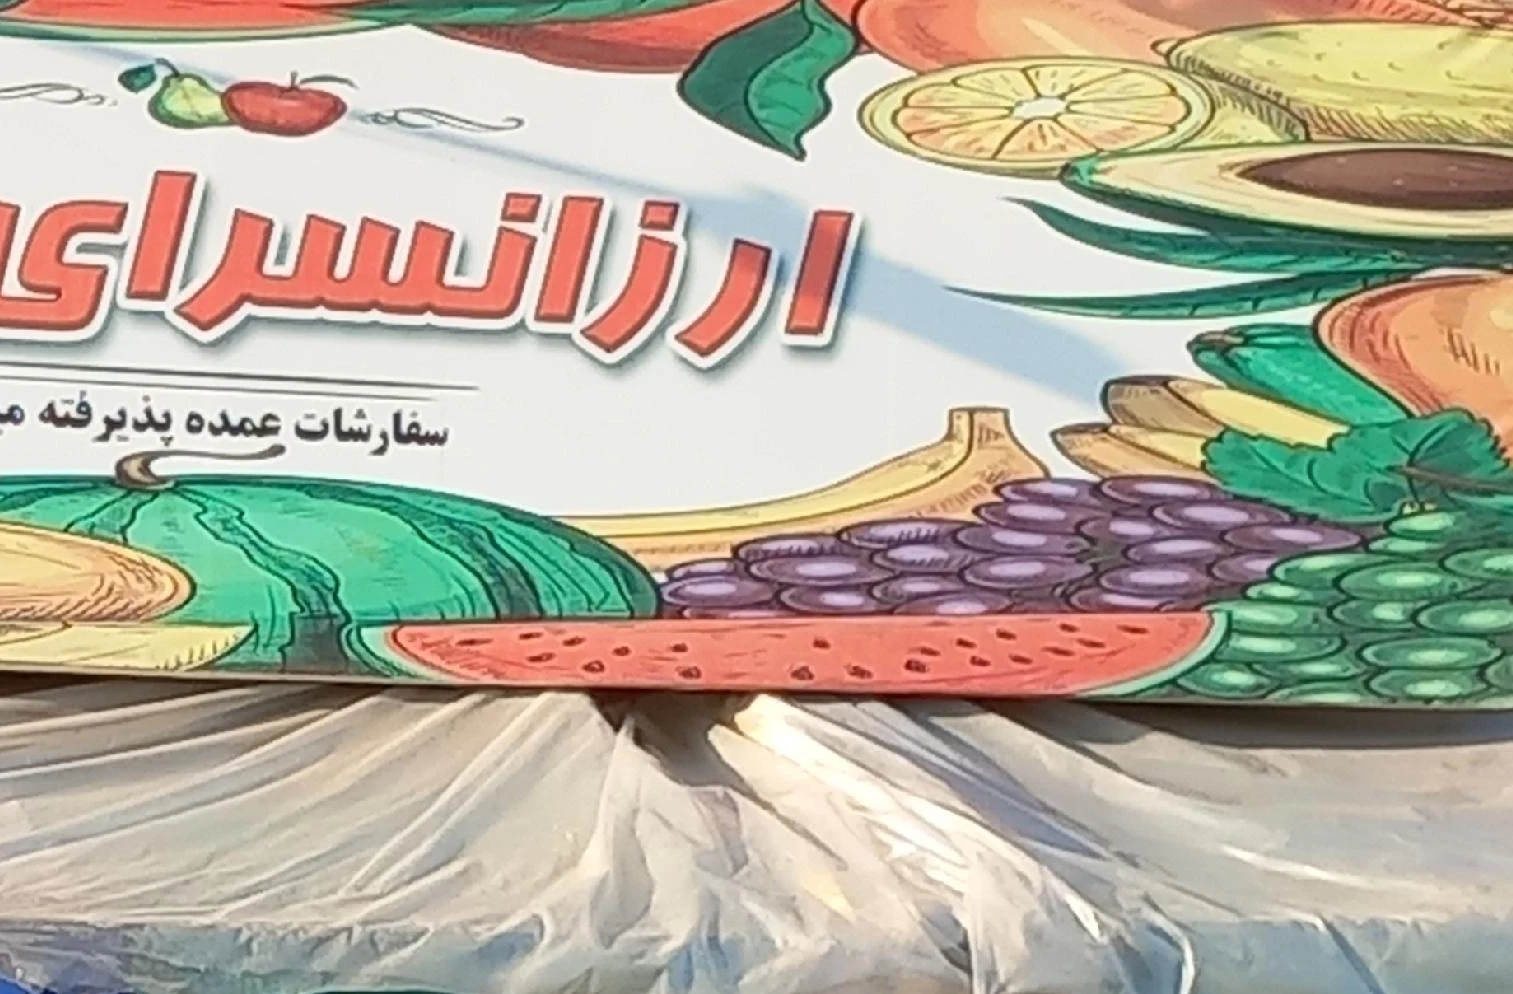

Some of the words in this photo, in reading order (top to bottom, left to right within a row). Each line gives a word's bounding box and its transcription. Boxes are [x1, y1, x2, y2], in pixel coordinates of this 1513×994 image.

[38, 391, 174, 446] پذیرفته
[186, 411, 282, 439] عمده
[295, 407, 448, 456] سفارشات
